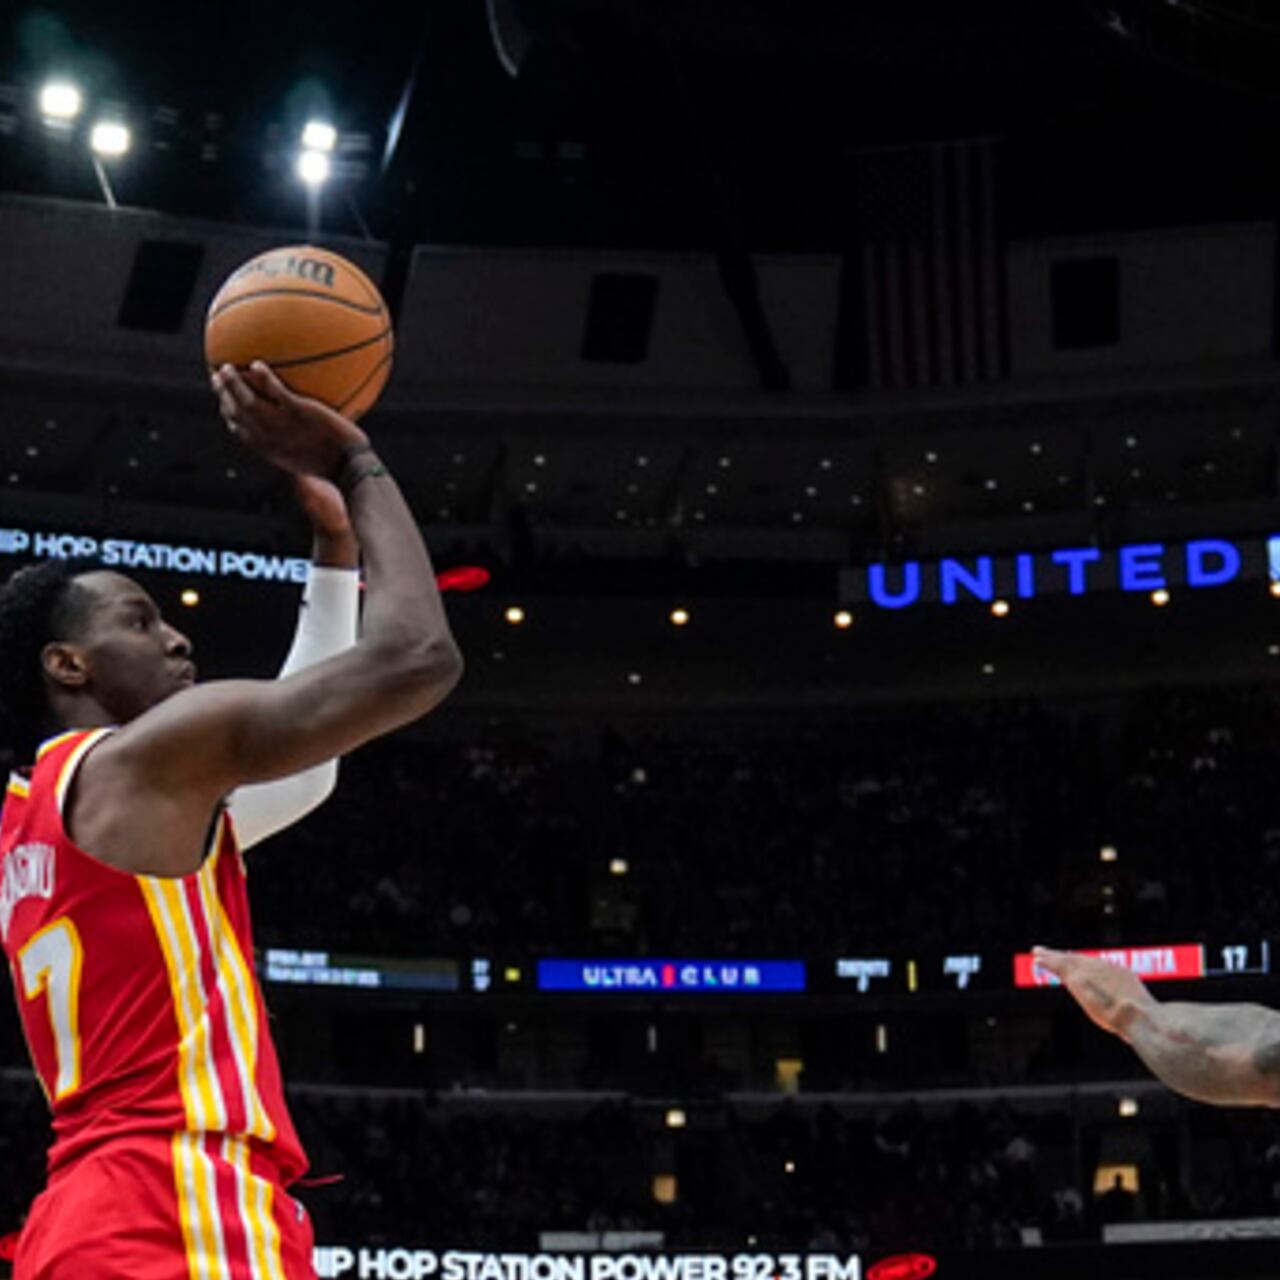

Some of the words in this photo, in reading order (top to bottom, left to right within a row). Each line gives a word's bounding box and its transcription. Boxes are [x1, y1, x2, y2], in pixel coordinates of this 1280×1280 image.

[34, 533, 98, 560] HOP
[100, 539, 217, 575] STATION
[221, 551, 312, 582] POWE
[867, 540, 1241, 609] UNITED
[582, 965, 657, 986] ULTRA
[680, 964, 760, 986] CLUB
[359, 1248, 438, 1280] HOP
